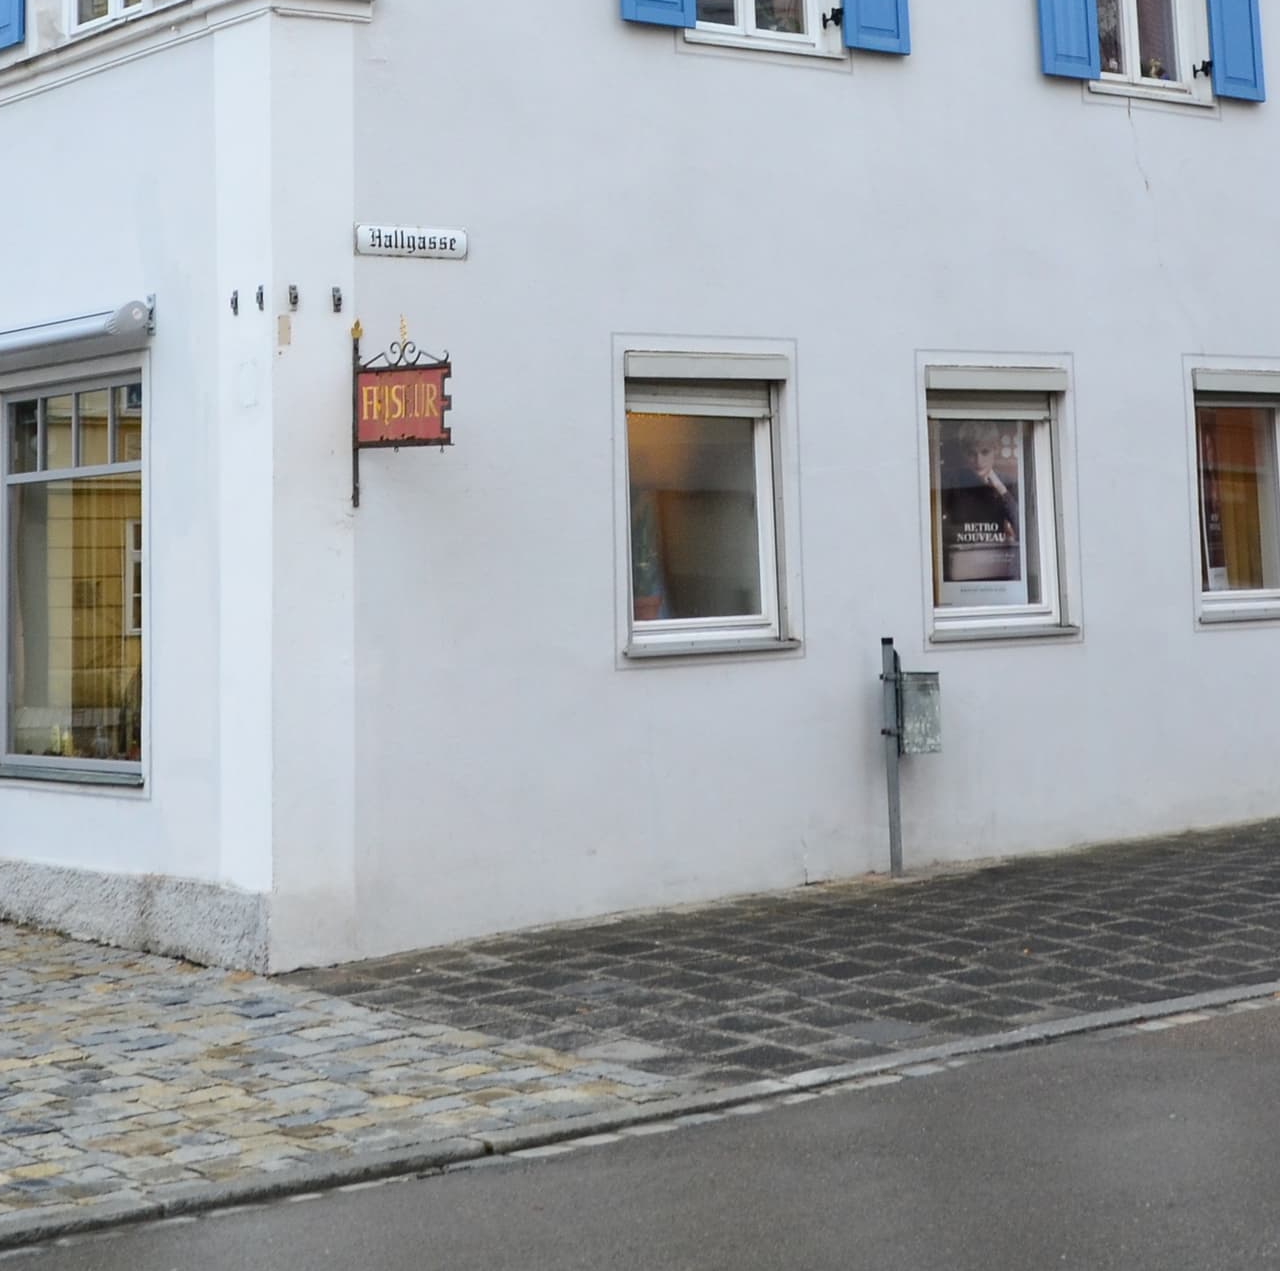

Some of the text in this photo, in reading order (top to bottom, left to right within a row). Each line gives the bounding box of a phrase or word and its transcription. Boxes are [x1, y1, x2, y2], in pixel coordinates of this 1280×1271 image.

[368, 228, 457, 254] Hallgasse
[964, 522, 999, 532] RETRO
[956, 532, 1006, 542] NOUVEAU
